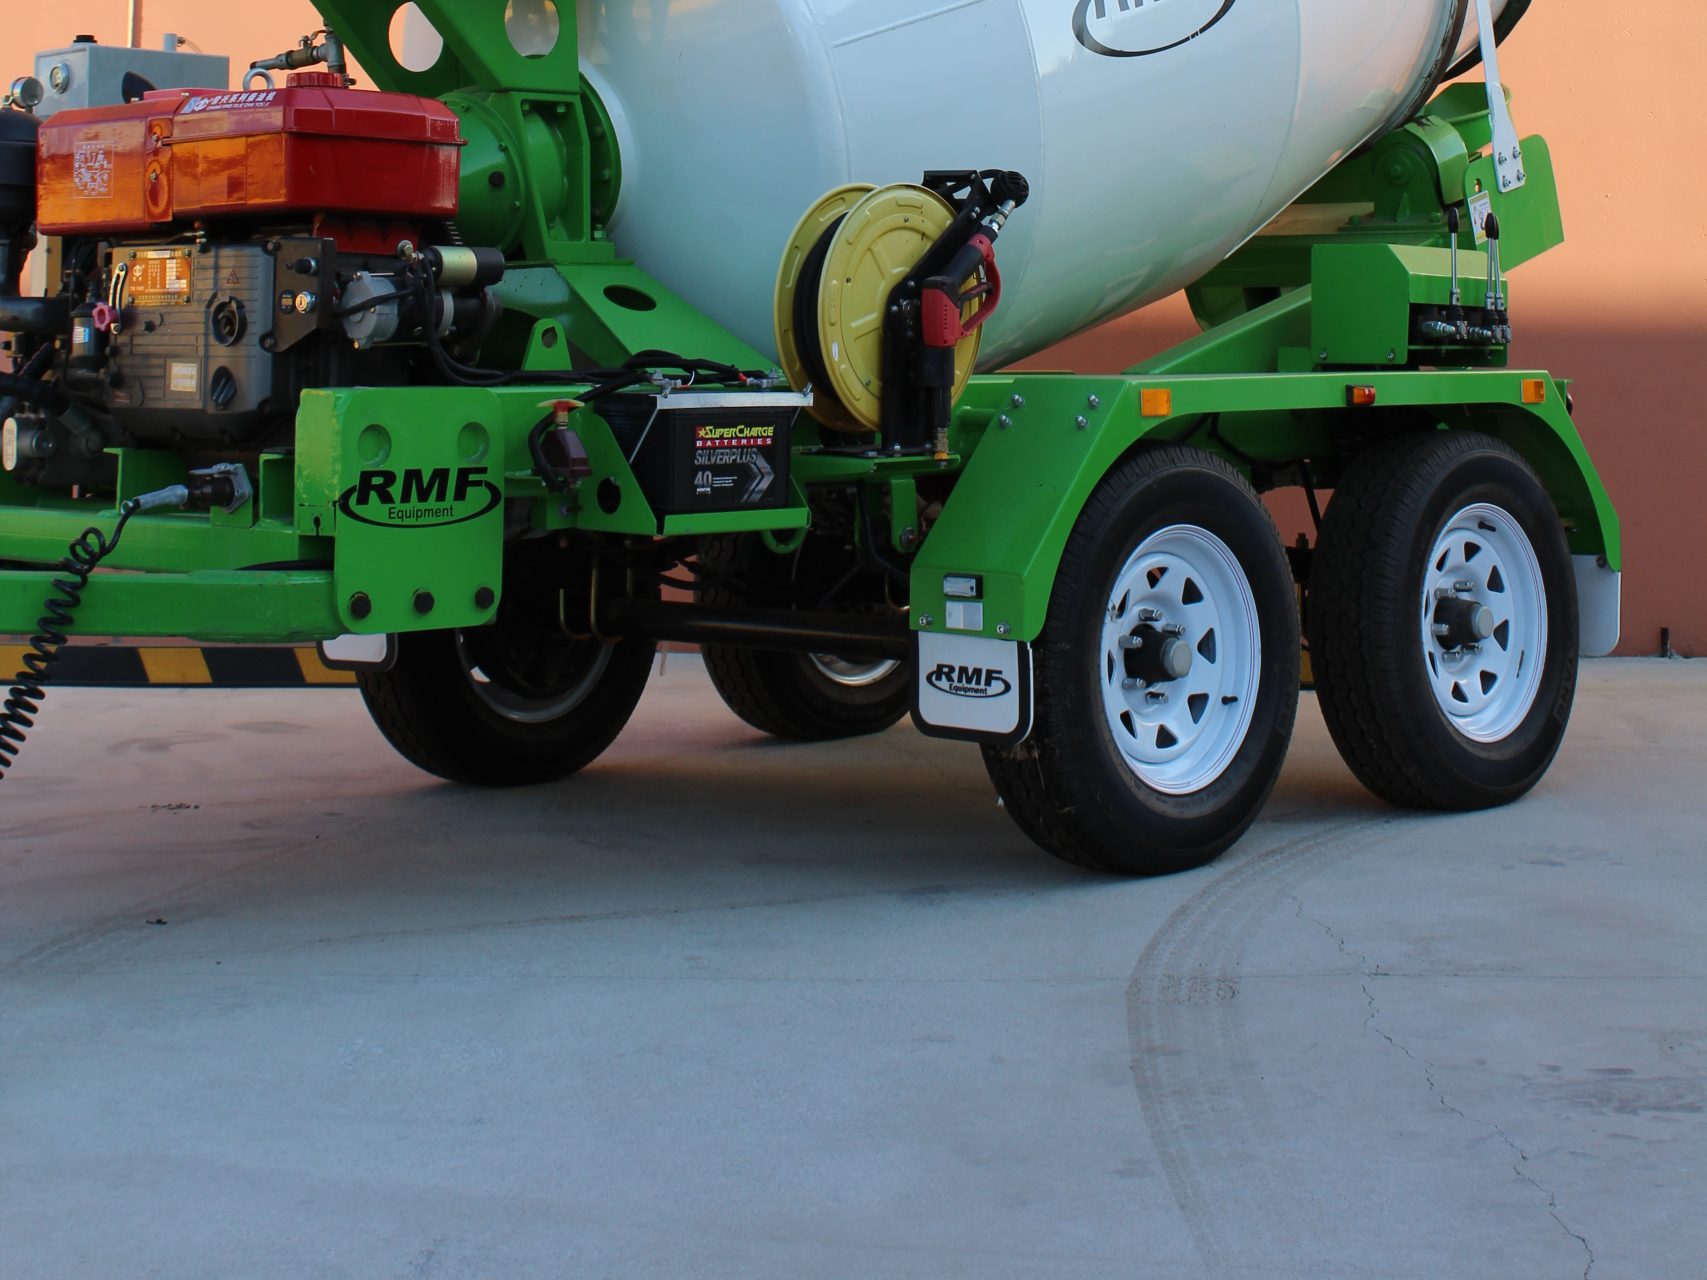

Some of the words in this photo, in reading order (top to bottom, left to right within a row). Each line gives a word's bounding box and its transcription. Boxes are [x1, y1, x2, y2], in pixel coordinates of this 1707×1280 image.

[696, 438, 772, 447] BATTERIES
[694, 448, 758, 465] SILVERPLUS
[355, 467, 488, 505] RMF
[694, 470, 712, 486] 40
[388, 505, 454, 522] Equipment
[935, 663, 1003, 687] RMF
[949, 683, 988, 696] Equipment
